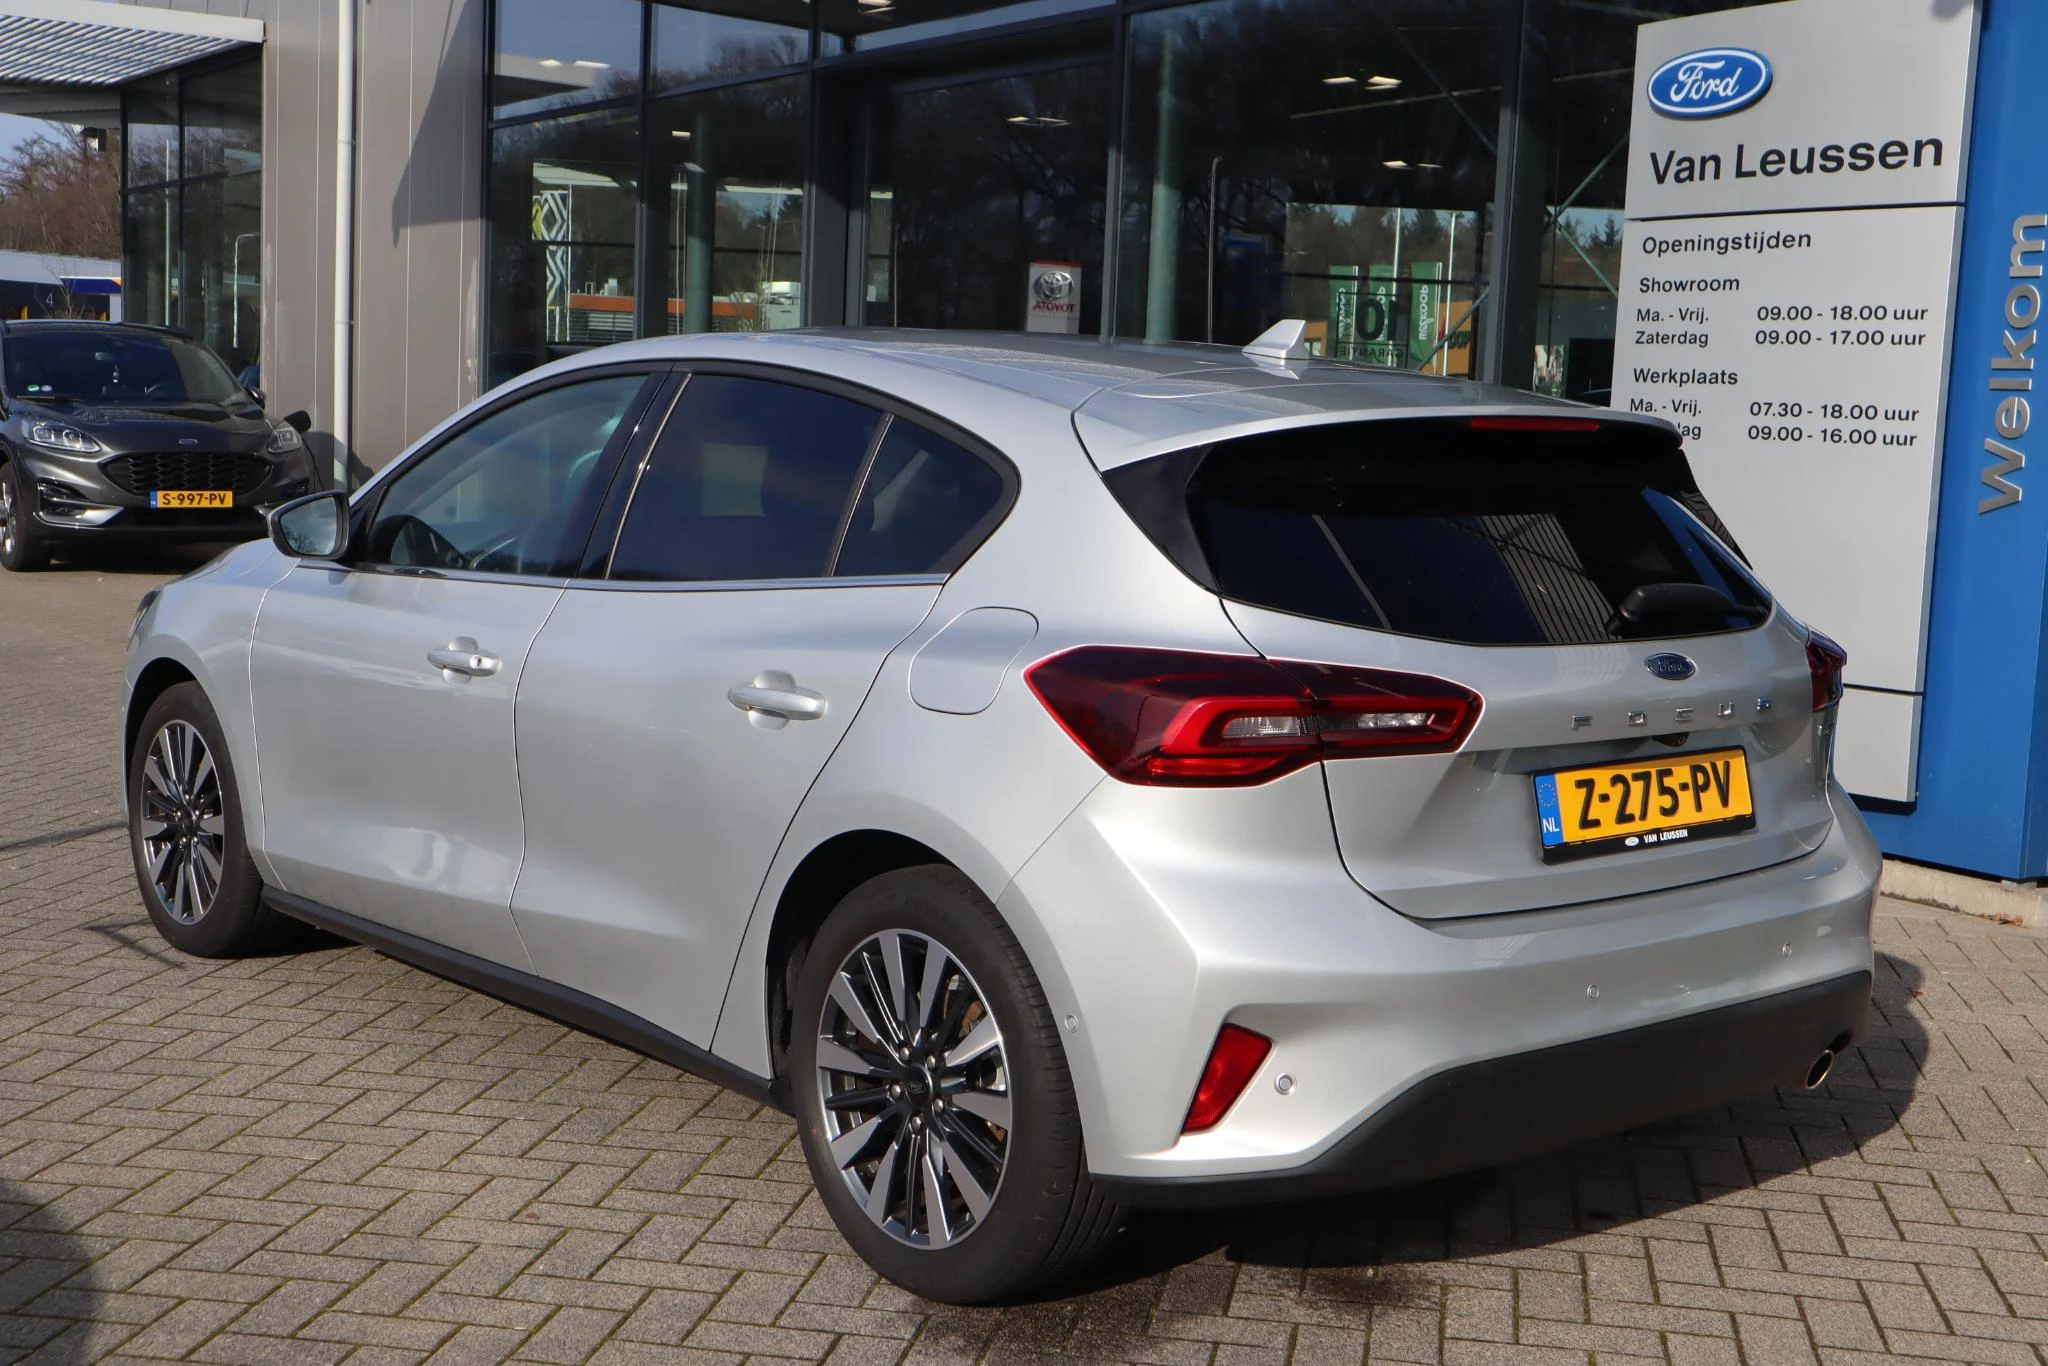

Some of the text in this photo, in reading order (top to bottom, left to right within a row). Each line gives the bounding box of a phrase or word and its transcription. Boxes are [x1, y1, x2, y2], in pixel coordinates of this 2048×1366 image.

[1670, 60, 1742, 103] Ford
[1649, 137, 1944, 185] Van Leussen
[1642, 230, 1812, 258] Openingstijden
[1639, 276, 1741, 294] Showroom
[46, 292, 54, 305] 4
[1636, 307, 1665, 322] Ma.
[1678, 307, 1710, 325] Vrij.
[1757, 305, 1813, 321] 09.00
[1830, 305, 1888, 321] 18.00
[1893, 308, 1929, 321] uur
[1635, 330, 1709, 348] Zaterdag
[1755, 329, 1812, 345] 09.00
[1830, 330, 1885, 346] 17.00
[1890, 334, 1926, 346] uur
[1978, 214, 2048, 514] Welkom
[1633, 367, 1738, 388] Werkplaats
[1630, 398, 1658, 413] Ma.
[1671, 399, 1703, 417] Vrij.
[1749, 401, 1803, 418] 07.30
[1820, 403, 1878, 421] 18.00
[1884, 408, 1920, 421] uur
[1748, 425, 1803, 442] 09.00
[1820, 428, 1877, 446] 16.00
[1882, 434, 1918, 447] uur
[162, 493, 227, 505] S-997-PV
[1571, 697, 1772, 730] FOCUS
[1574, 760, 1731, 831] Z-275-PV
[1543, 816, 1560, 833] NL
[1643, 832, 1658, 844] VAN
[1659, 828, 1689, 842] LEUSSEN
